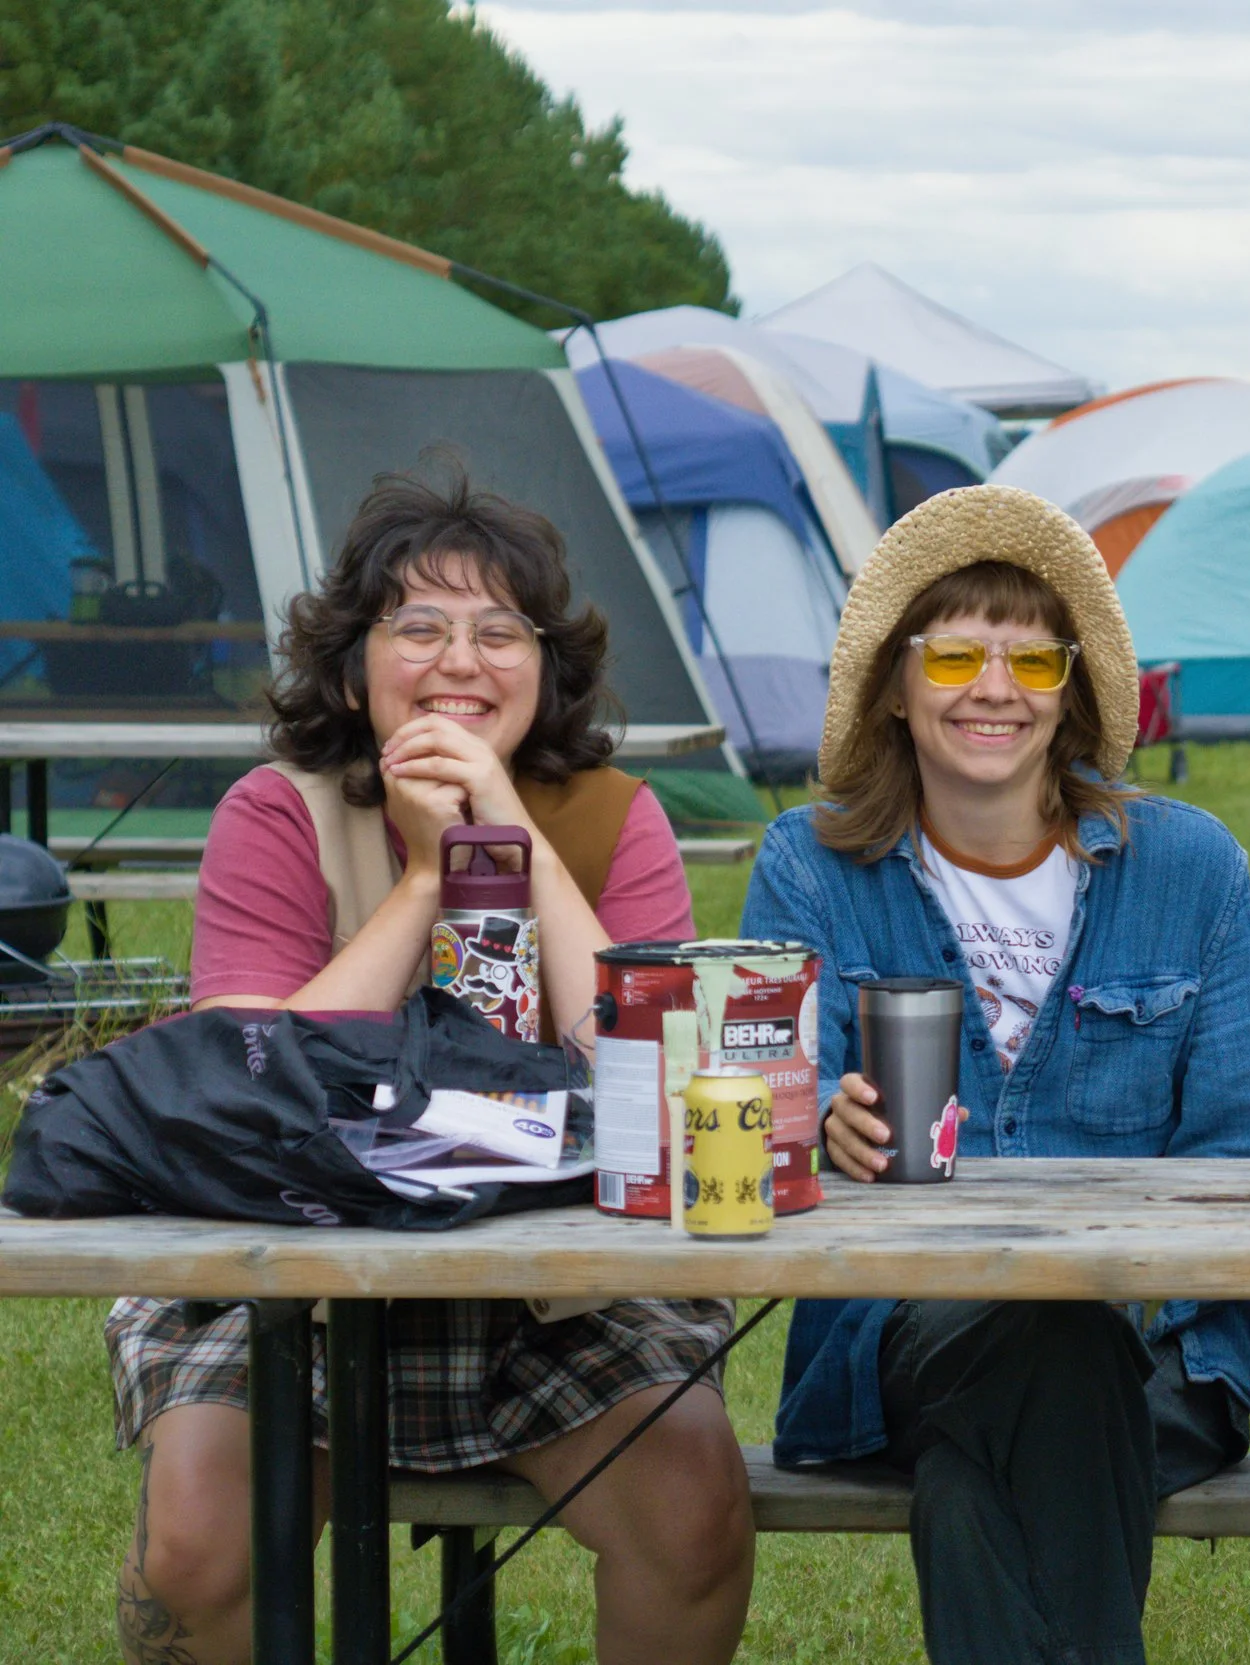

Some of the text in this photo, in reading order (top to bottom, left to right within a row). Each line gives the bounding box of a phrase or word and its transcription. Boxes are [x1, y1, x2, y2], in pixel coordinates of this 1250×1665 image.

[957, 923, 1055, 949] LWAYS
[723, 1023, 775, 1047] BEHR
[724, 1048, 791, 1061] ULTRA
[684, 1107, 721, 1132] ors
[773, 1151, 790, 1168] ION
